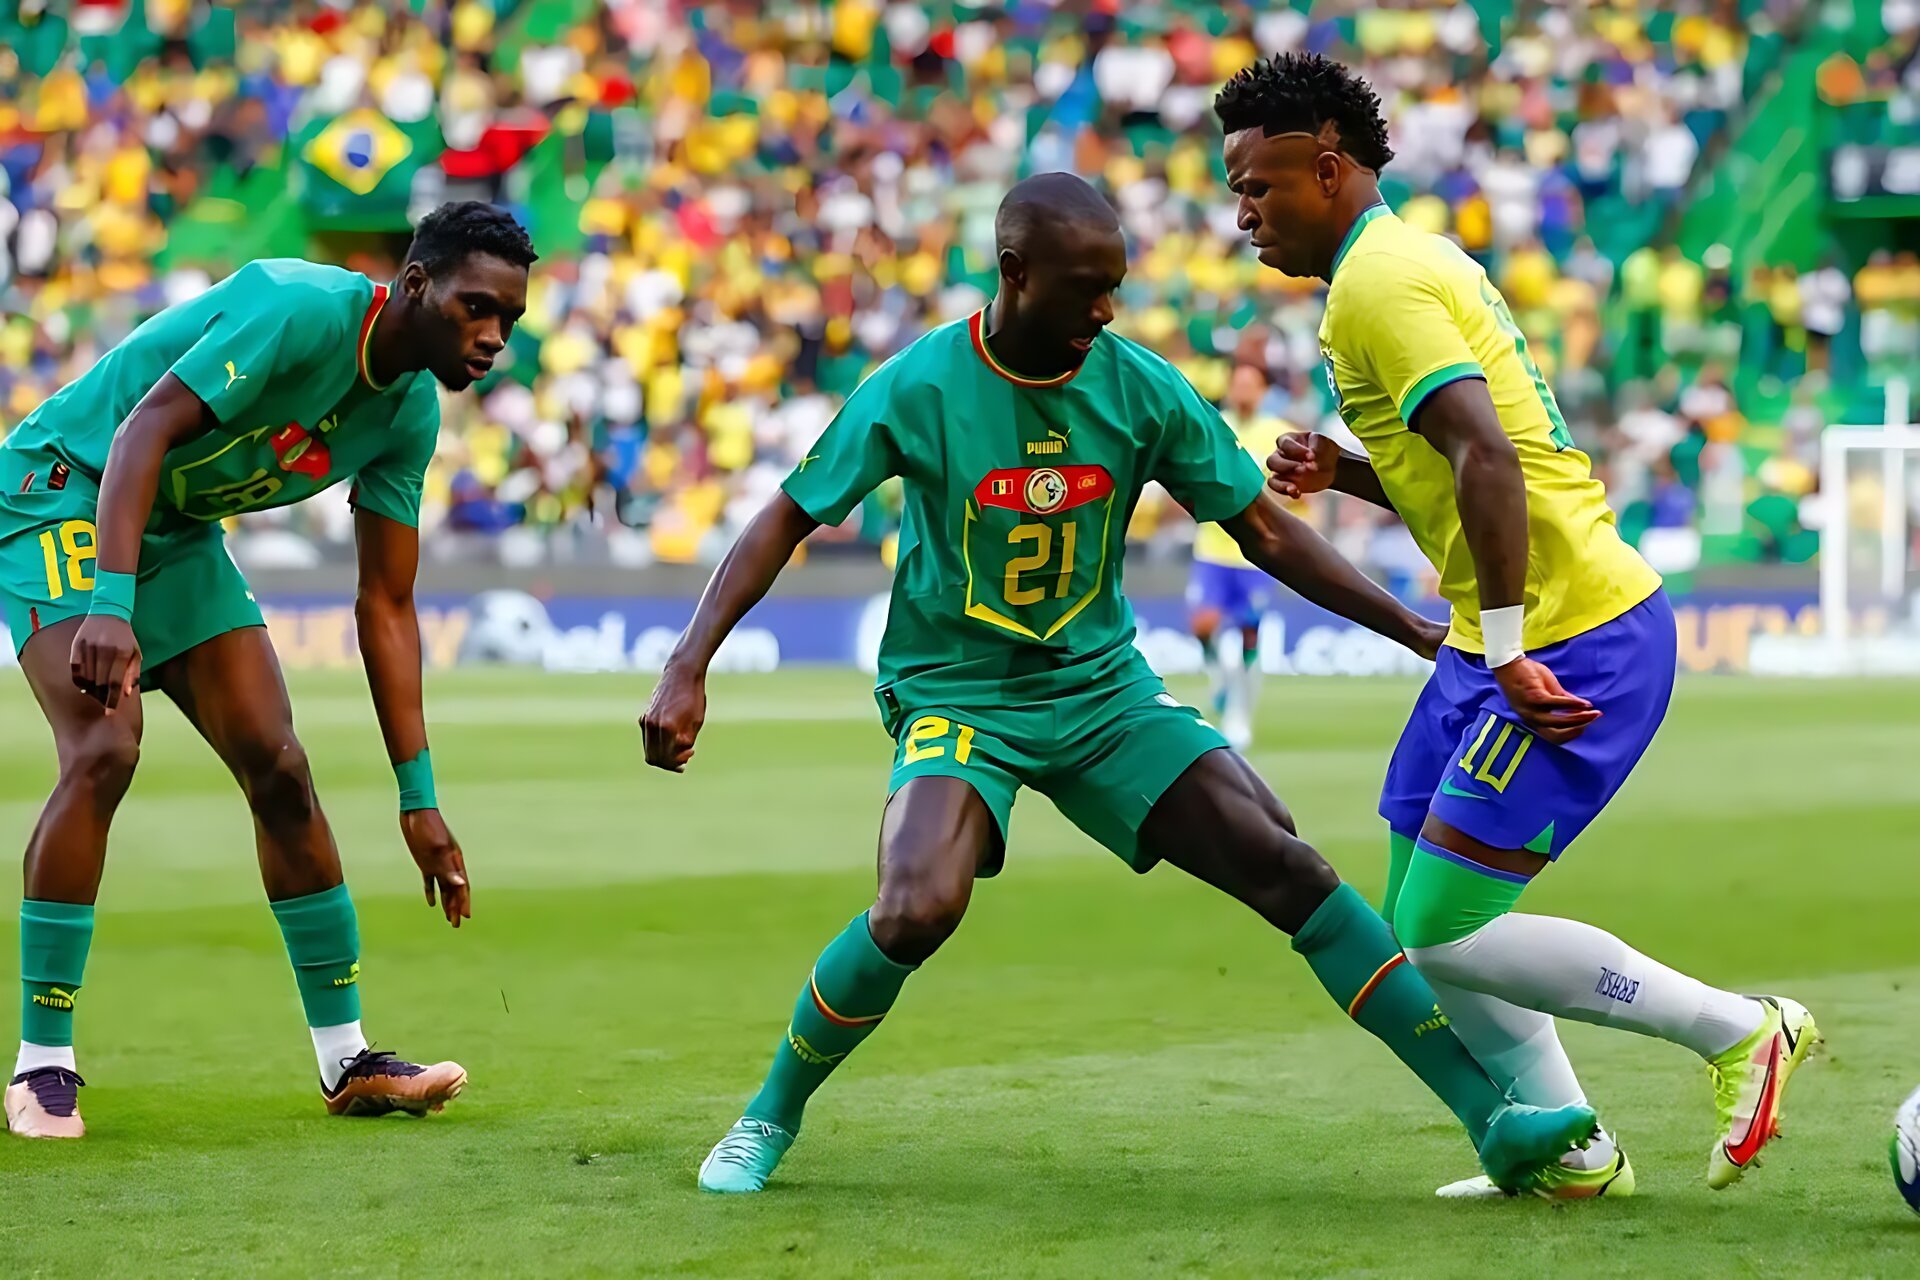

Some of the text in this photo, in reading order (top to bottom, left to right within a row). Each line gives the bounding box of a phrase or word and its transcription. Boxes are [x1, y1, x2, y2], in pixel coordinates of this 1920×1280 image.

[1027, 440, 1063, 455] PUMA
[39, 519, 97, 600] 18
[1004, 521, 1077, 606] 21
[903, 715, 976, 766] 21
[1457, 713, 1535, 795] 10
[1594, 966, 1641, 1005] BRASIL
